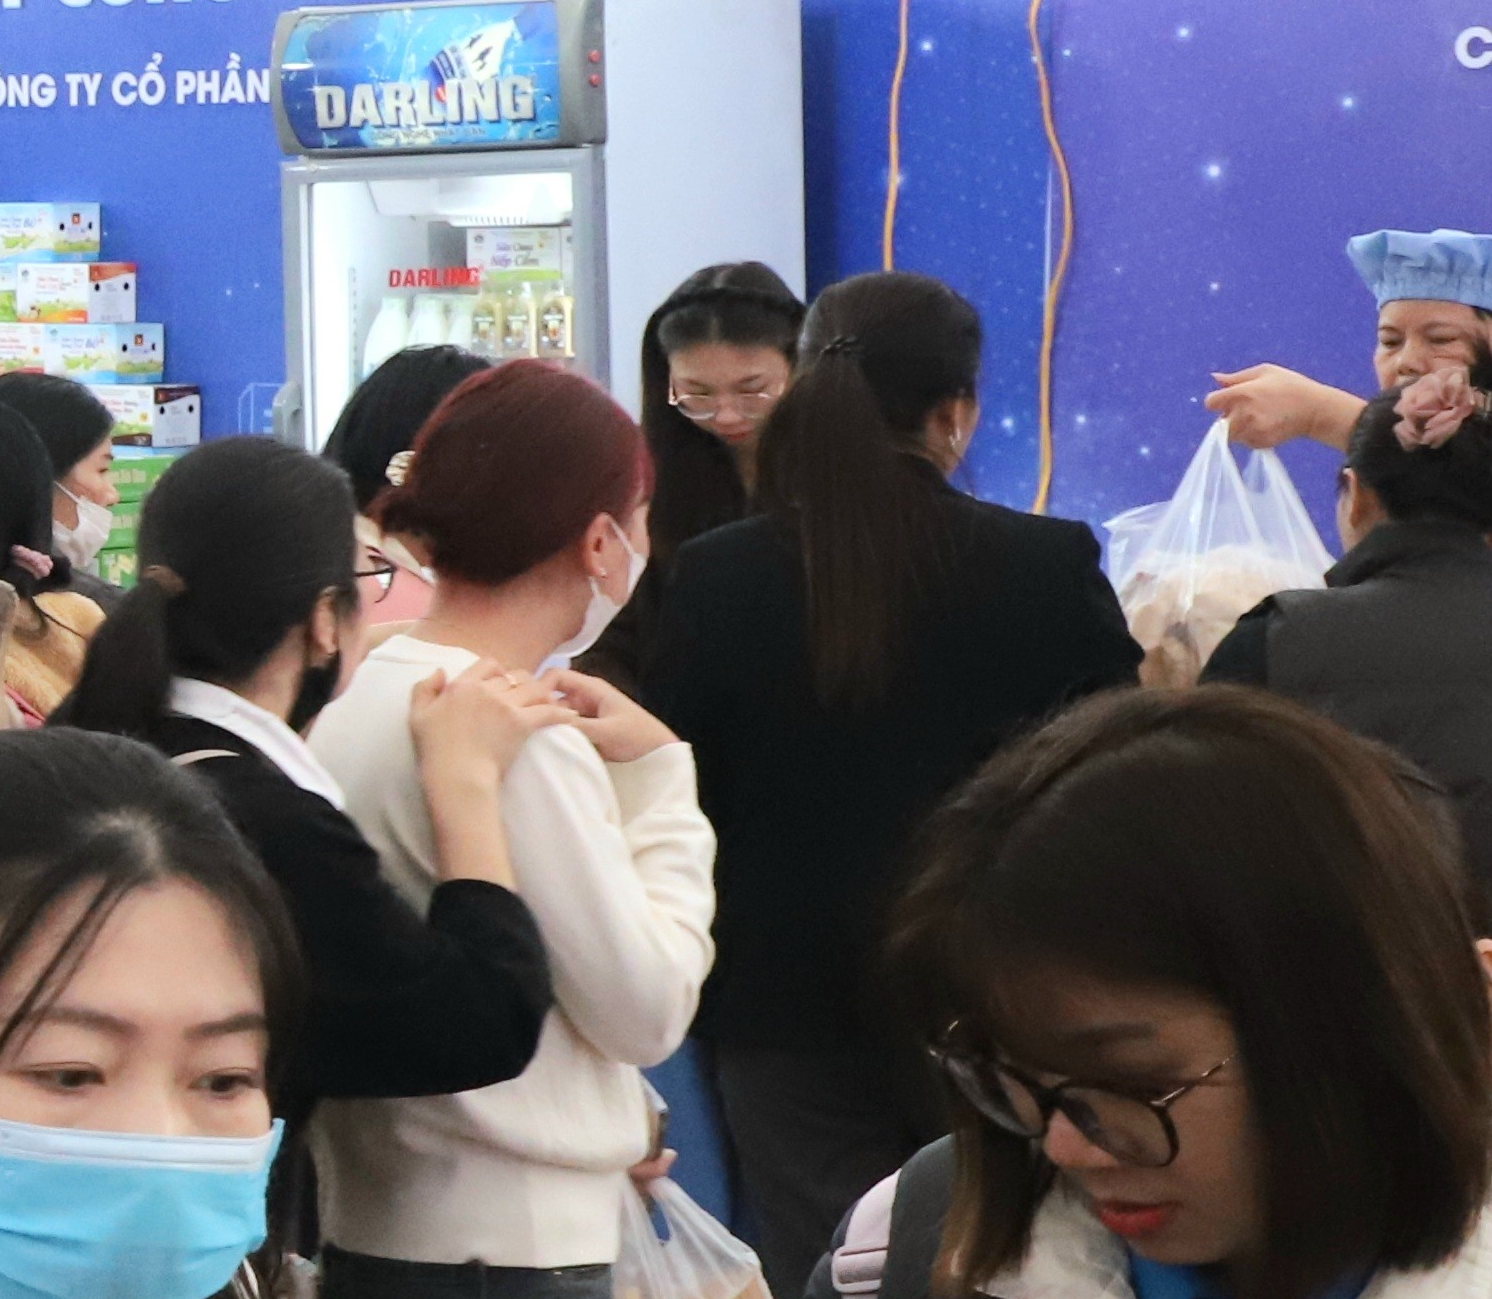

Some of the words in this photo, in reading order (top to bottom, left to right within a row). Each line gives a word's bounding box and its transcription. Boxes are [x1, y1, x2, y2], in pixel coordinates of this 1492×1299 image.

[65, 73, 103, 107] TY
[111, 51, 166, 107] CỔ
[176, 51, 271, 105] PHẦN
[311, 74, 538, 130] DARLING
